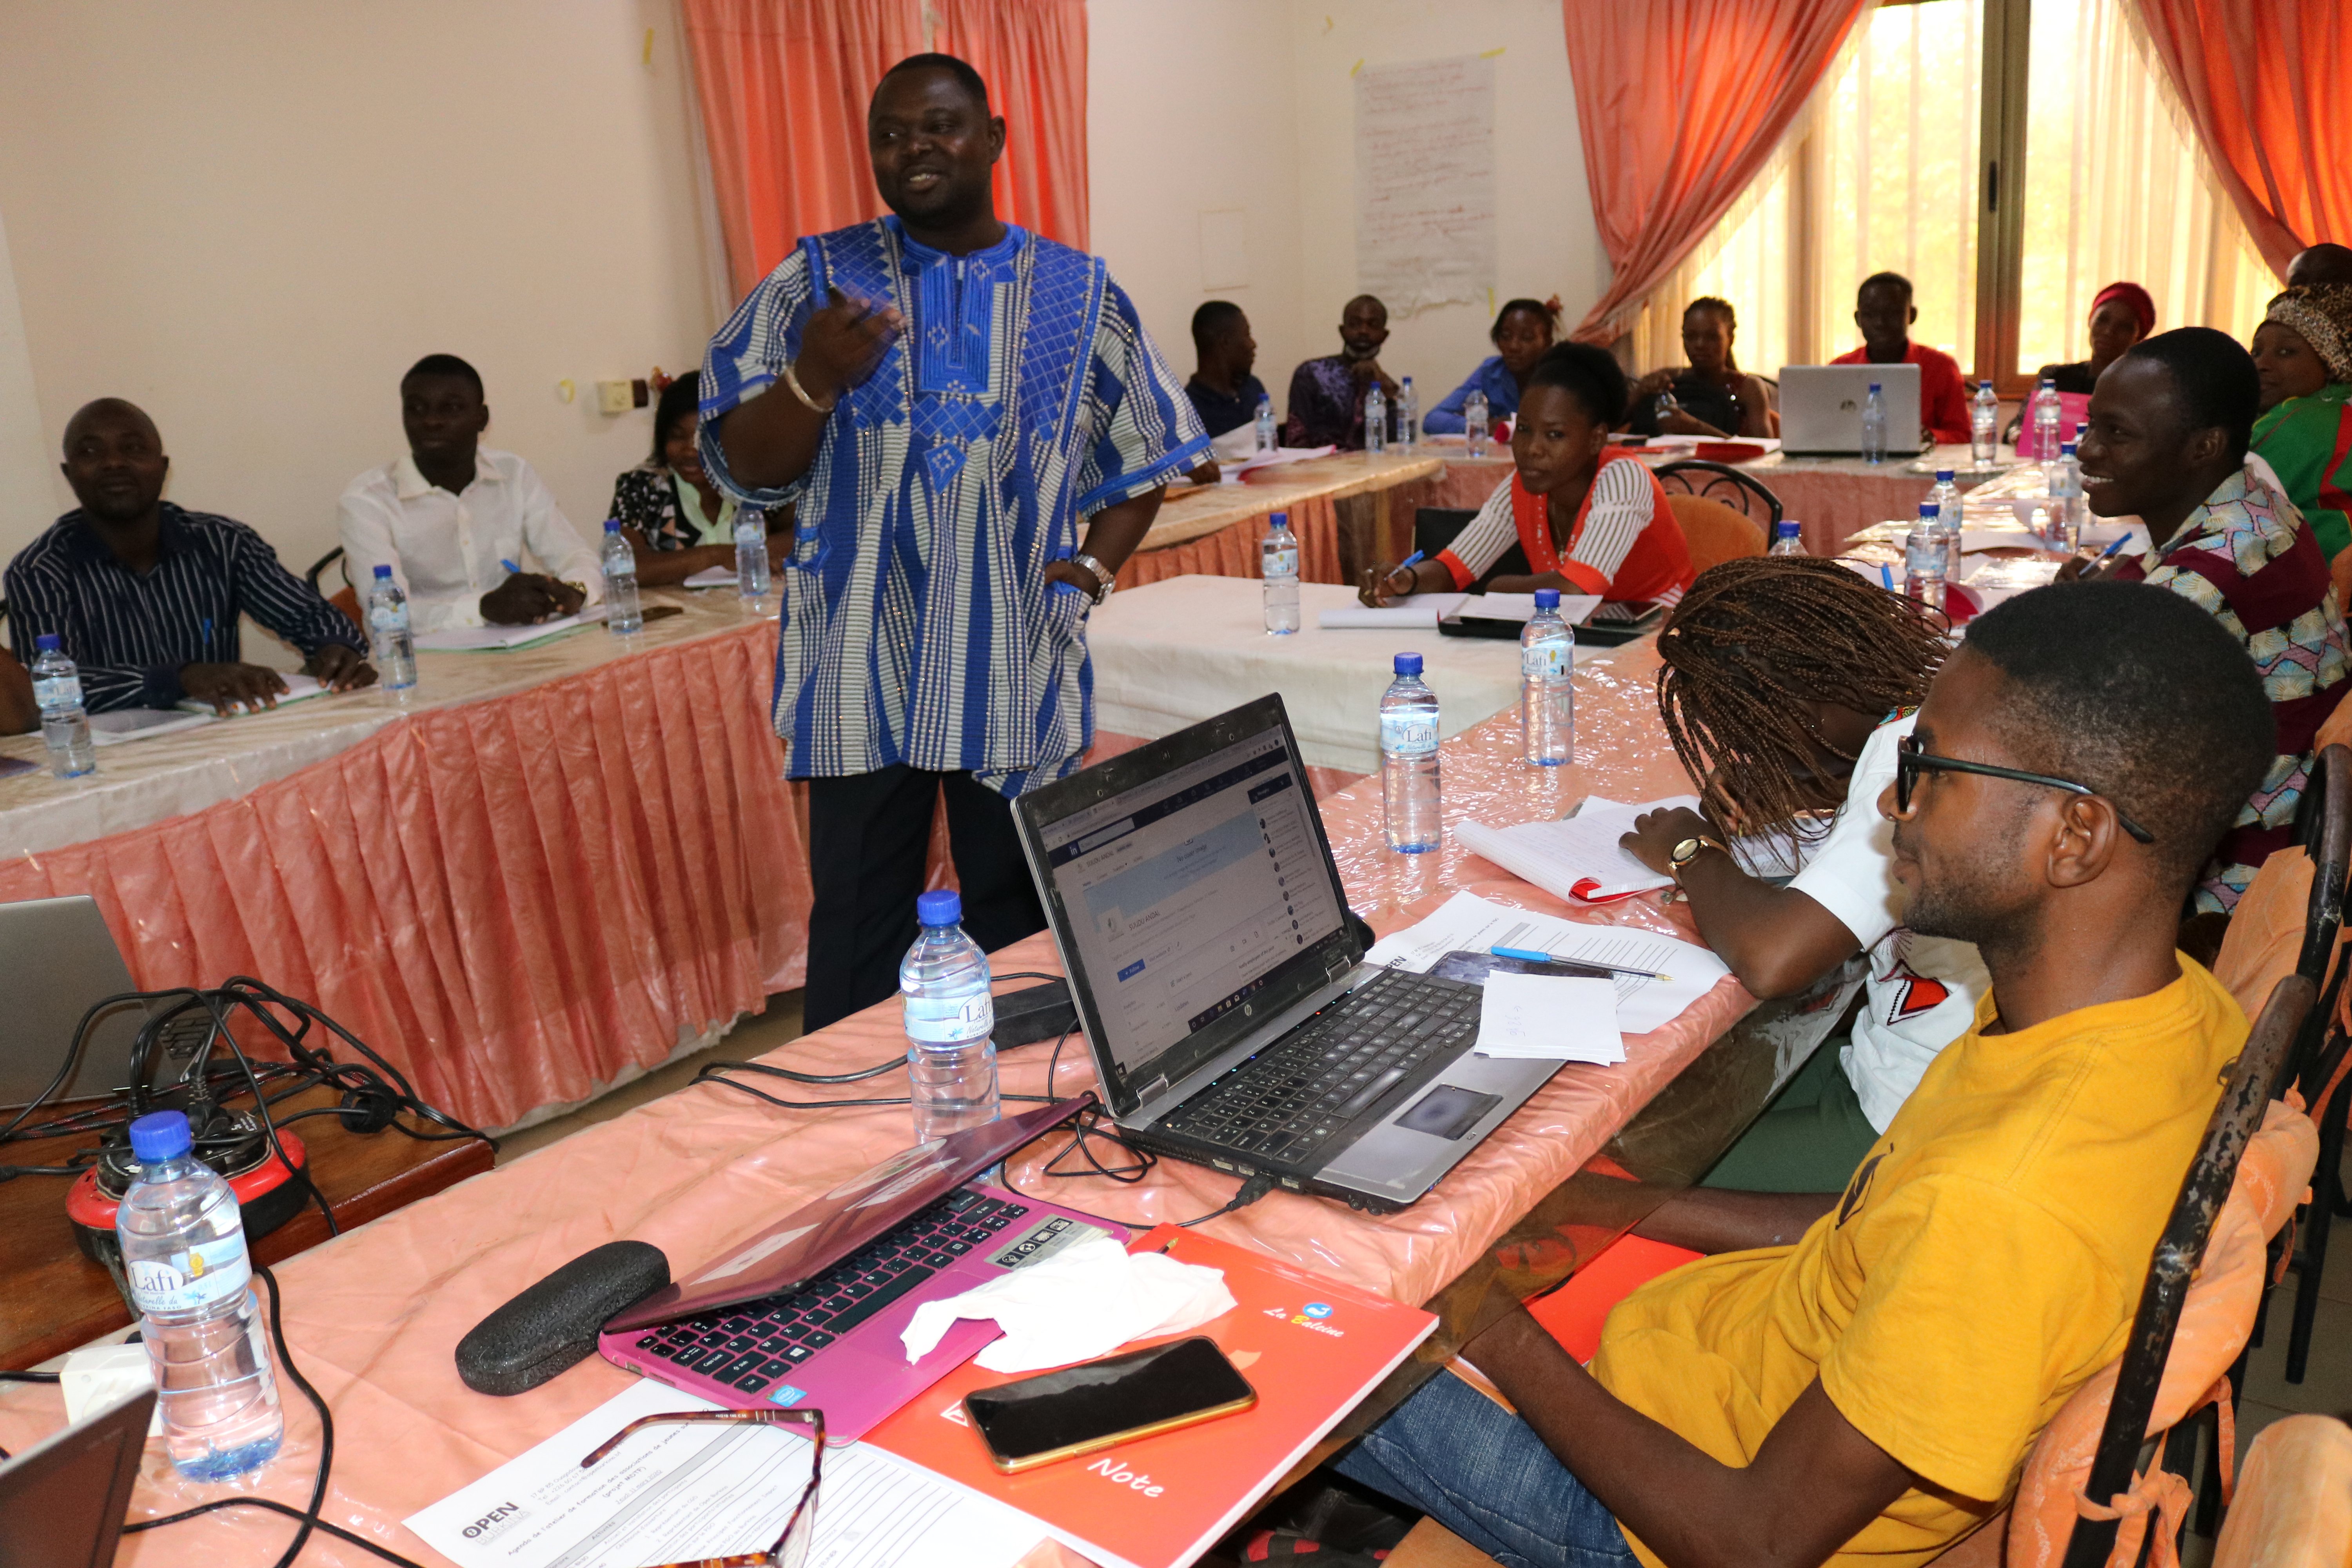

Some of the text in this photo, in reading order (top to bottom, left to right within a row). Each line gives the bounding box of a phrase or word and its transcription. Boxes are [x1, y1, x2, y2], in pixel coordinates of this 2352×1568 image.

[1407, 728, 1431, 742] Lafi
[1127, 909, 1161, 931] SUUDU ANDAL
[1385, 956, 1406, 968] PEN
[964, 996, 991, 1023] Lafi
[967, 1030, 986, 1038] BURKINA
[131, 1267, 175, 1291] Lafi
[1263, 1308, 1344, 1337] La Baleine
[507, 1421, 690, 1557] Agenda de l'atelier de formation des associations de jeunes sur
[602, 1464, 646, 1499] (projet MDTF)
[1087, 1458, 1164, 1497] Note
[462, 1501, 520, 1538] OPEN
[475, 1509, 531, 1545] BURKINA
[591, 1520, 616, 1541] Activités
